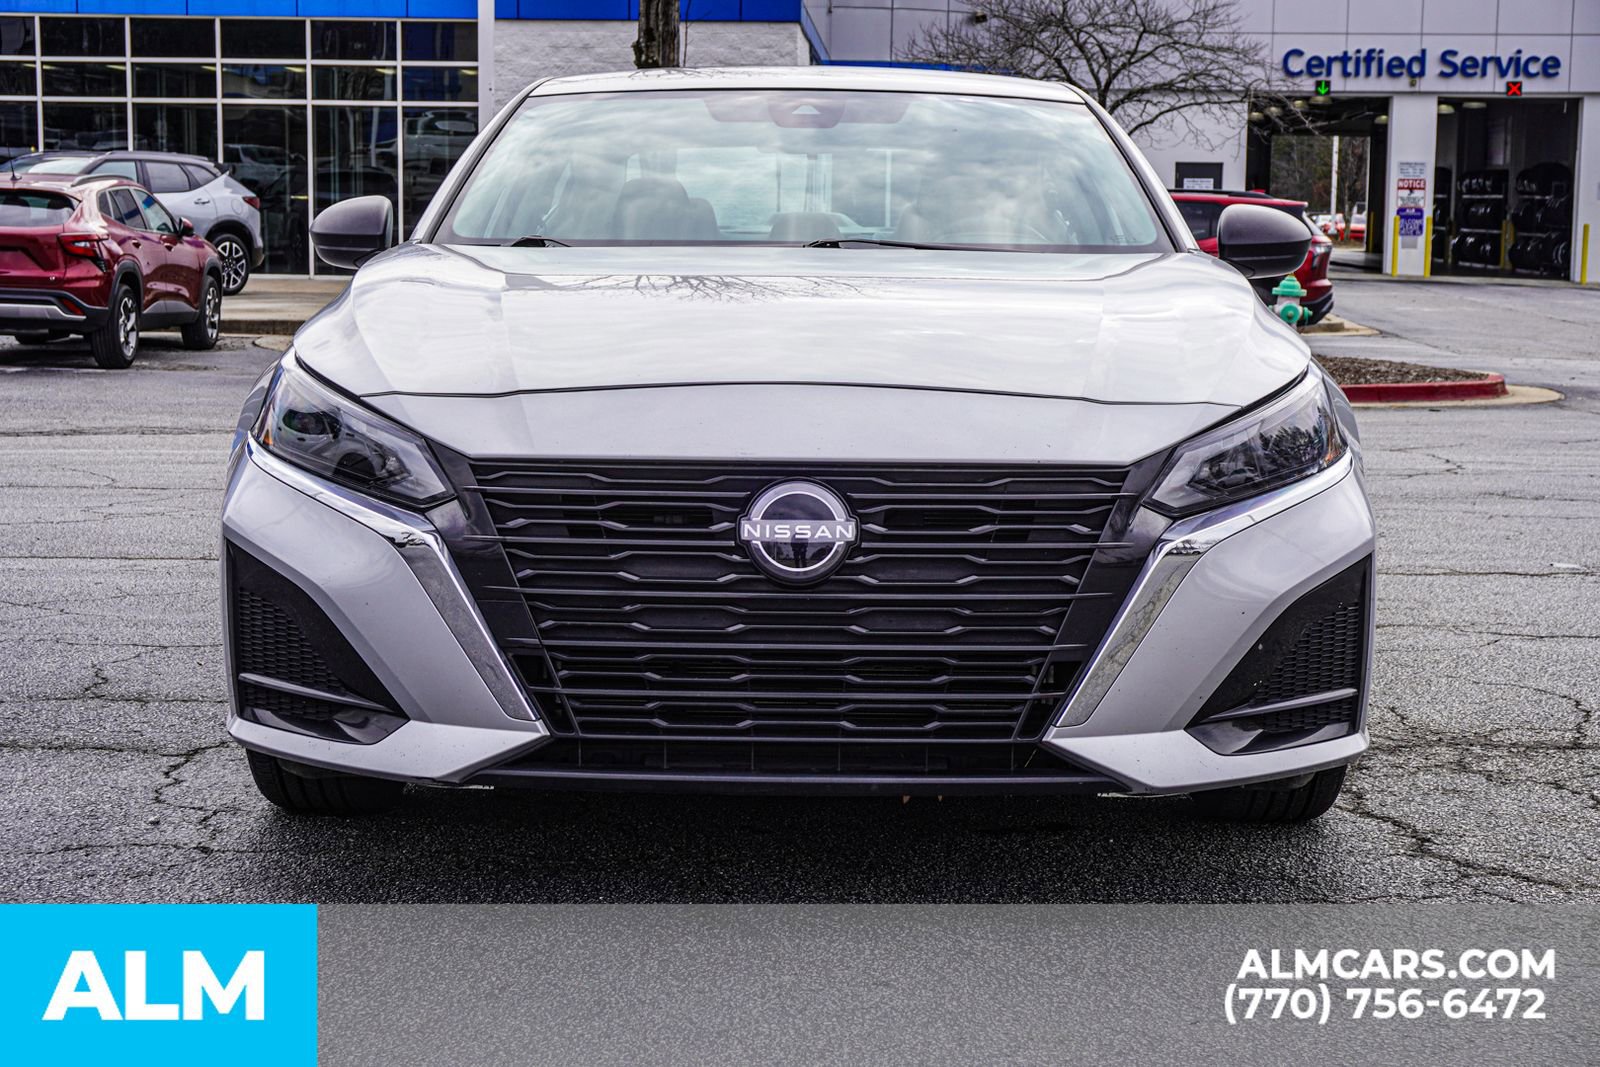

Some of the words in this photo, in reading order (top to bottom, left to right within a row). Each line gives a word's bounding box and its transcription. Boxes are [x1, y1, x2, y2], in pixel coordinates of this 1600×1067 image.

[1282, 48, 1427, 79] Certified
[1437, 48, 1562, 79] Service
[1398, 179, 1425, 188] NOTICE
[743, 524, 853, 539] NISSAN
